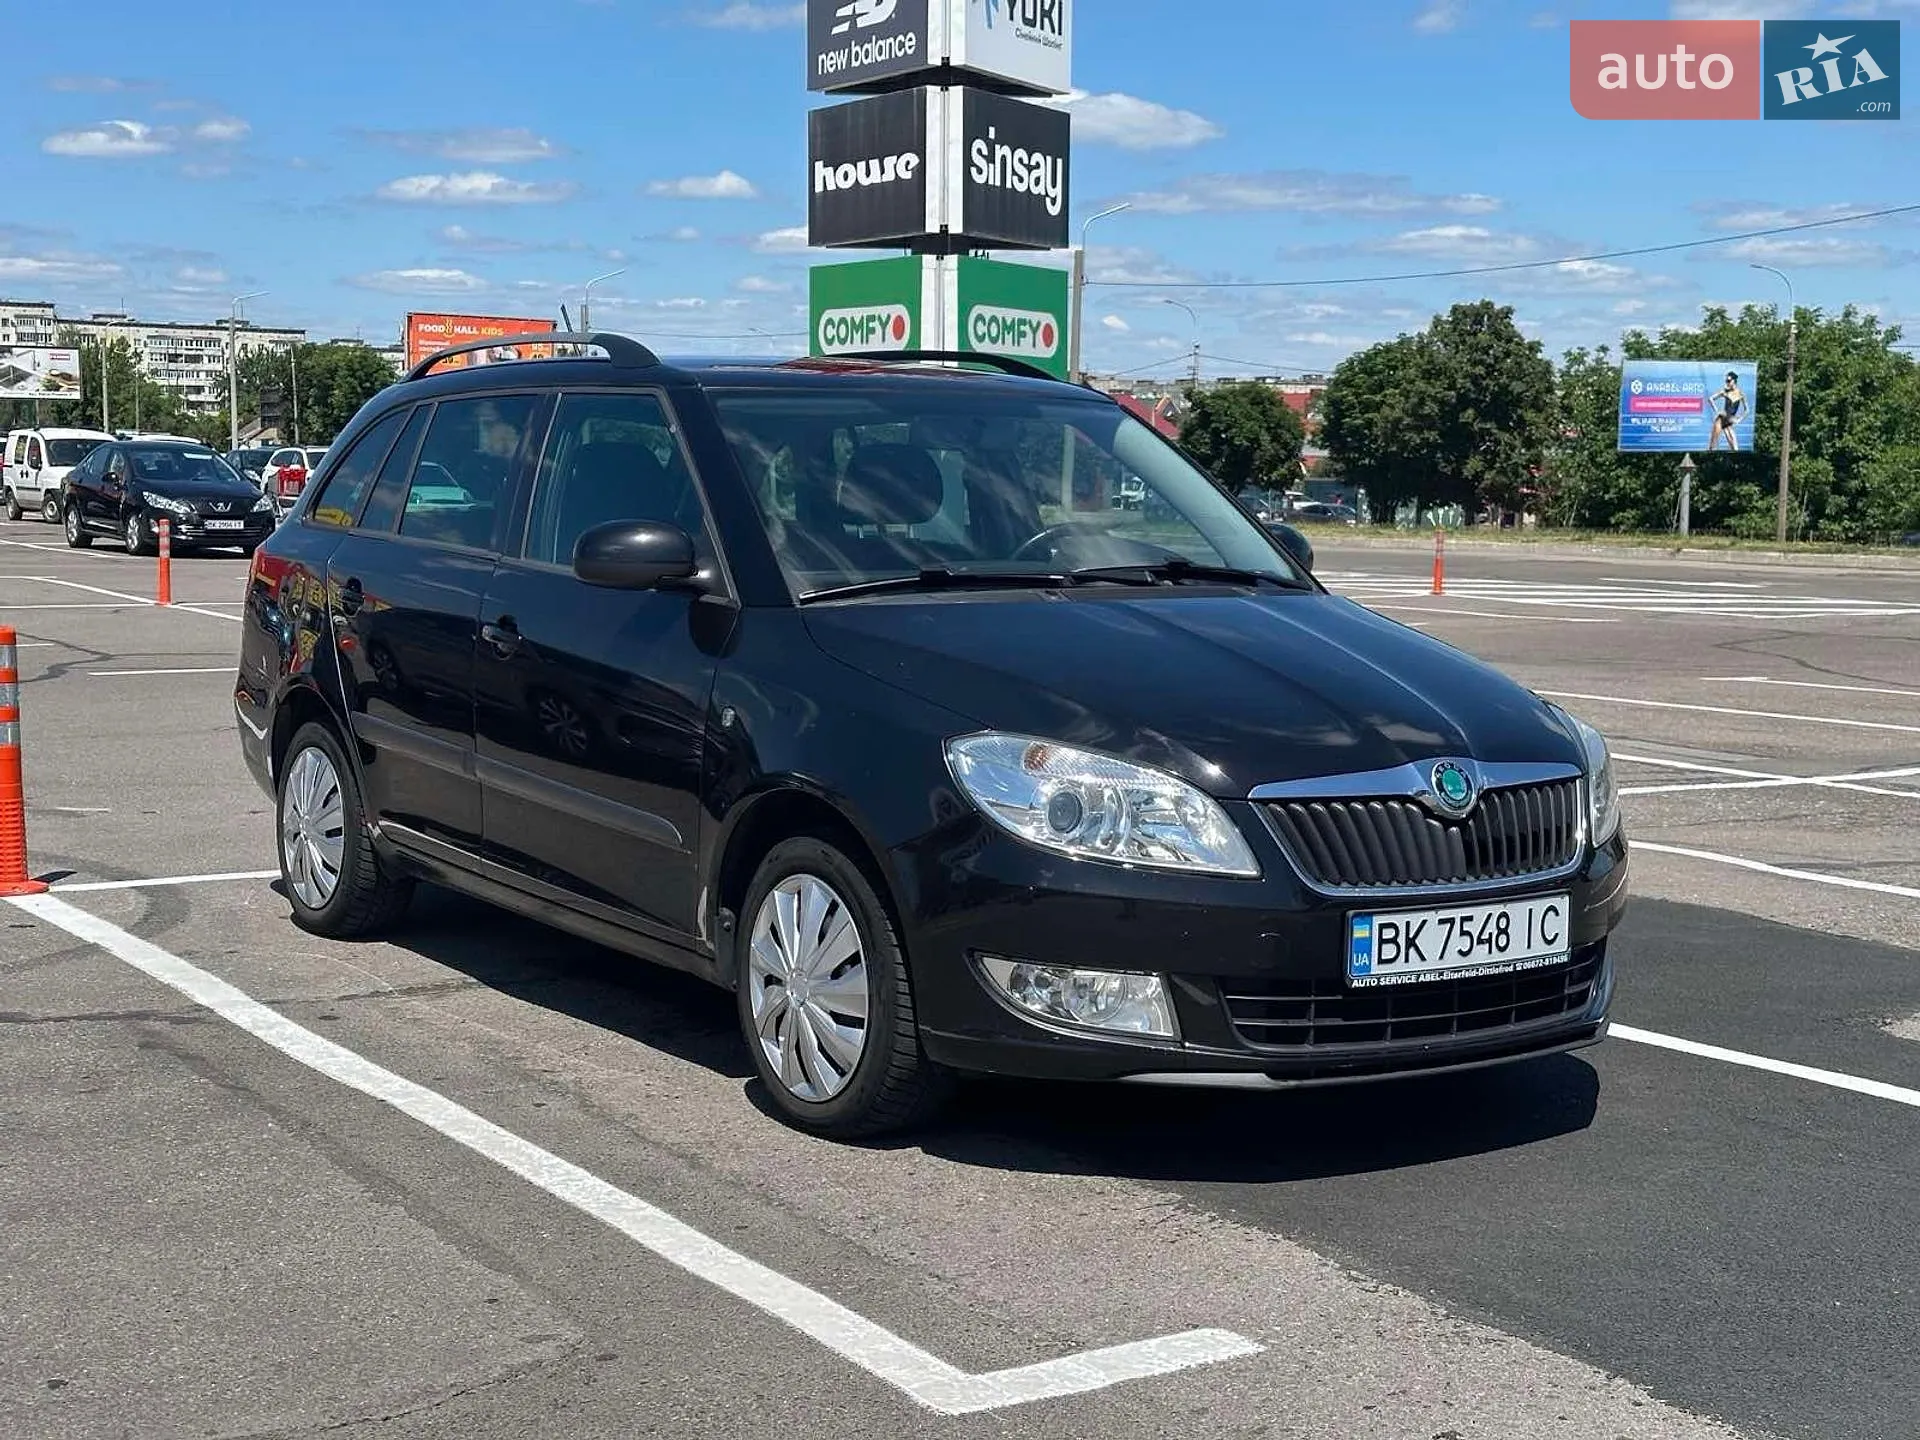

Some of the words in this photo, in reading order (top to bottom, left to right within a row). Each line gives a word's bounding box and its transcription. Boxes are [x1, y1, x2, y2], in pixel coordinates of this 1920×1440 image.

[818, 48, 848, 75] new
[851, 31, 916, 68] balance
[814, 152, 919, 193] house
[970, 126, 1063, 216] sinsay
[418, 324, 443, 333] FOOD
[454, 325, 479, 335] HALL
[480, 327, 505, 336] KIDS
[823, 313, 891, 347] COMFY
[973, 313, 1041, 348] COMFY
[1377, 918, 1428, 965] BK
[1437, 911, 1511, 960] 7548
[1526, 904, 1560, 949] IC
[1353, 952, 1369, 966] UA
[1351, 978, 1377, 989] AUTO
[1379, 974, 1417, 986] SERVICE
